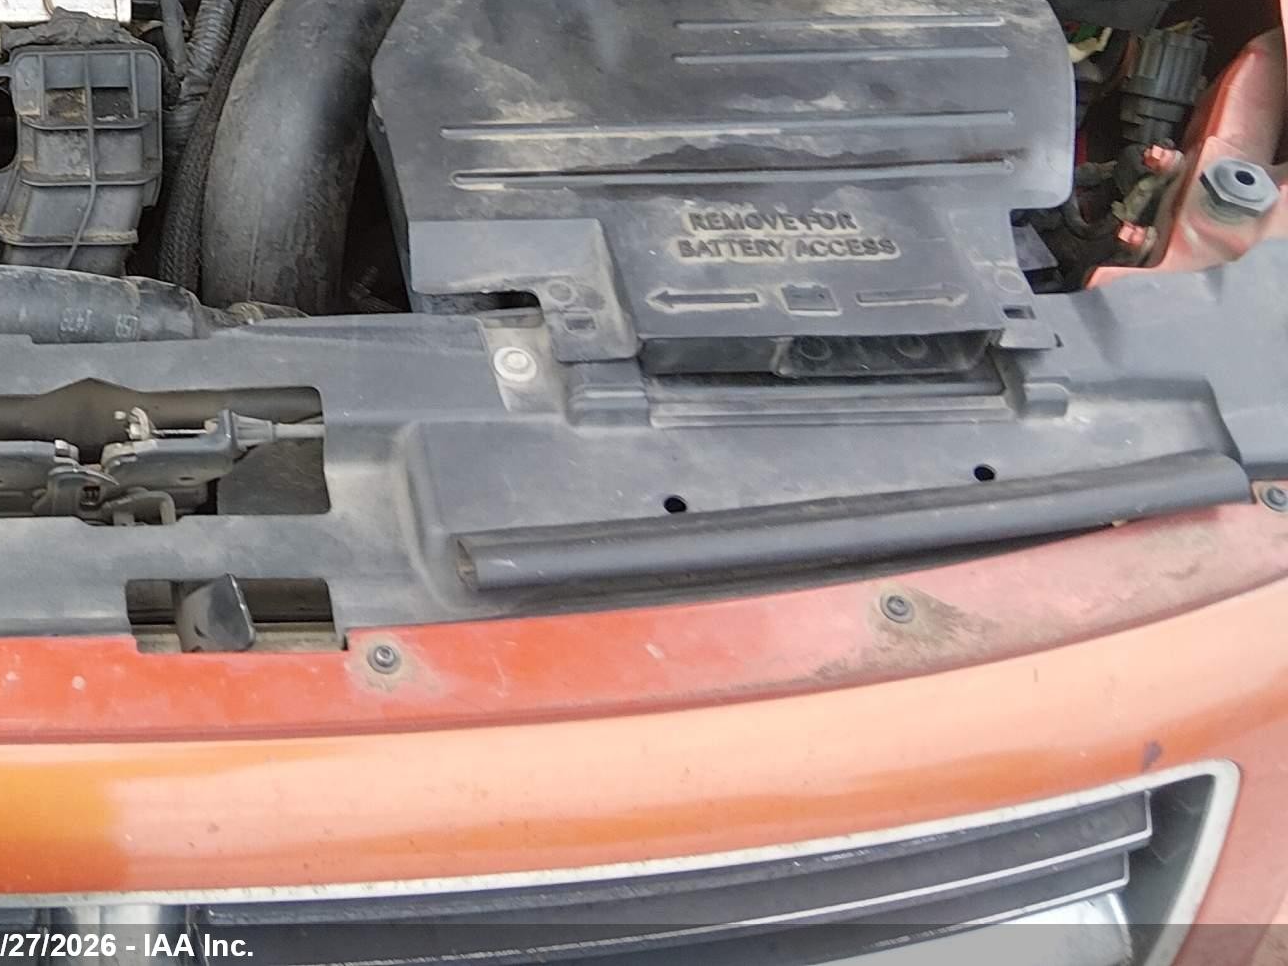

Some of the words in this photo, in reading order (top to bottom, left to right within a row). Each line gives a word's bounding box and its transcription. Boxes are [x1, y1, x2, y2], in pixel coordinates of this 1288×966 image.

[687, 211, 798, 232] REMOVE
[802, 210, 859, 231] FOR
[676, 238, 786, 258] BATTERY
[793, 237, 898, 257] ACCESS
